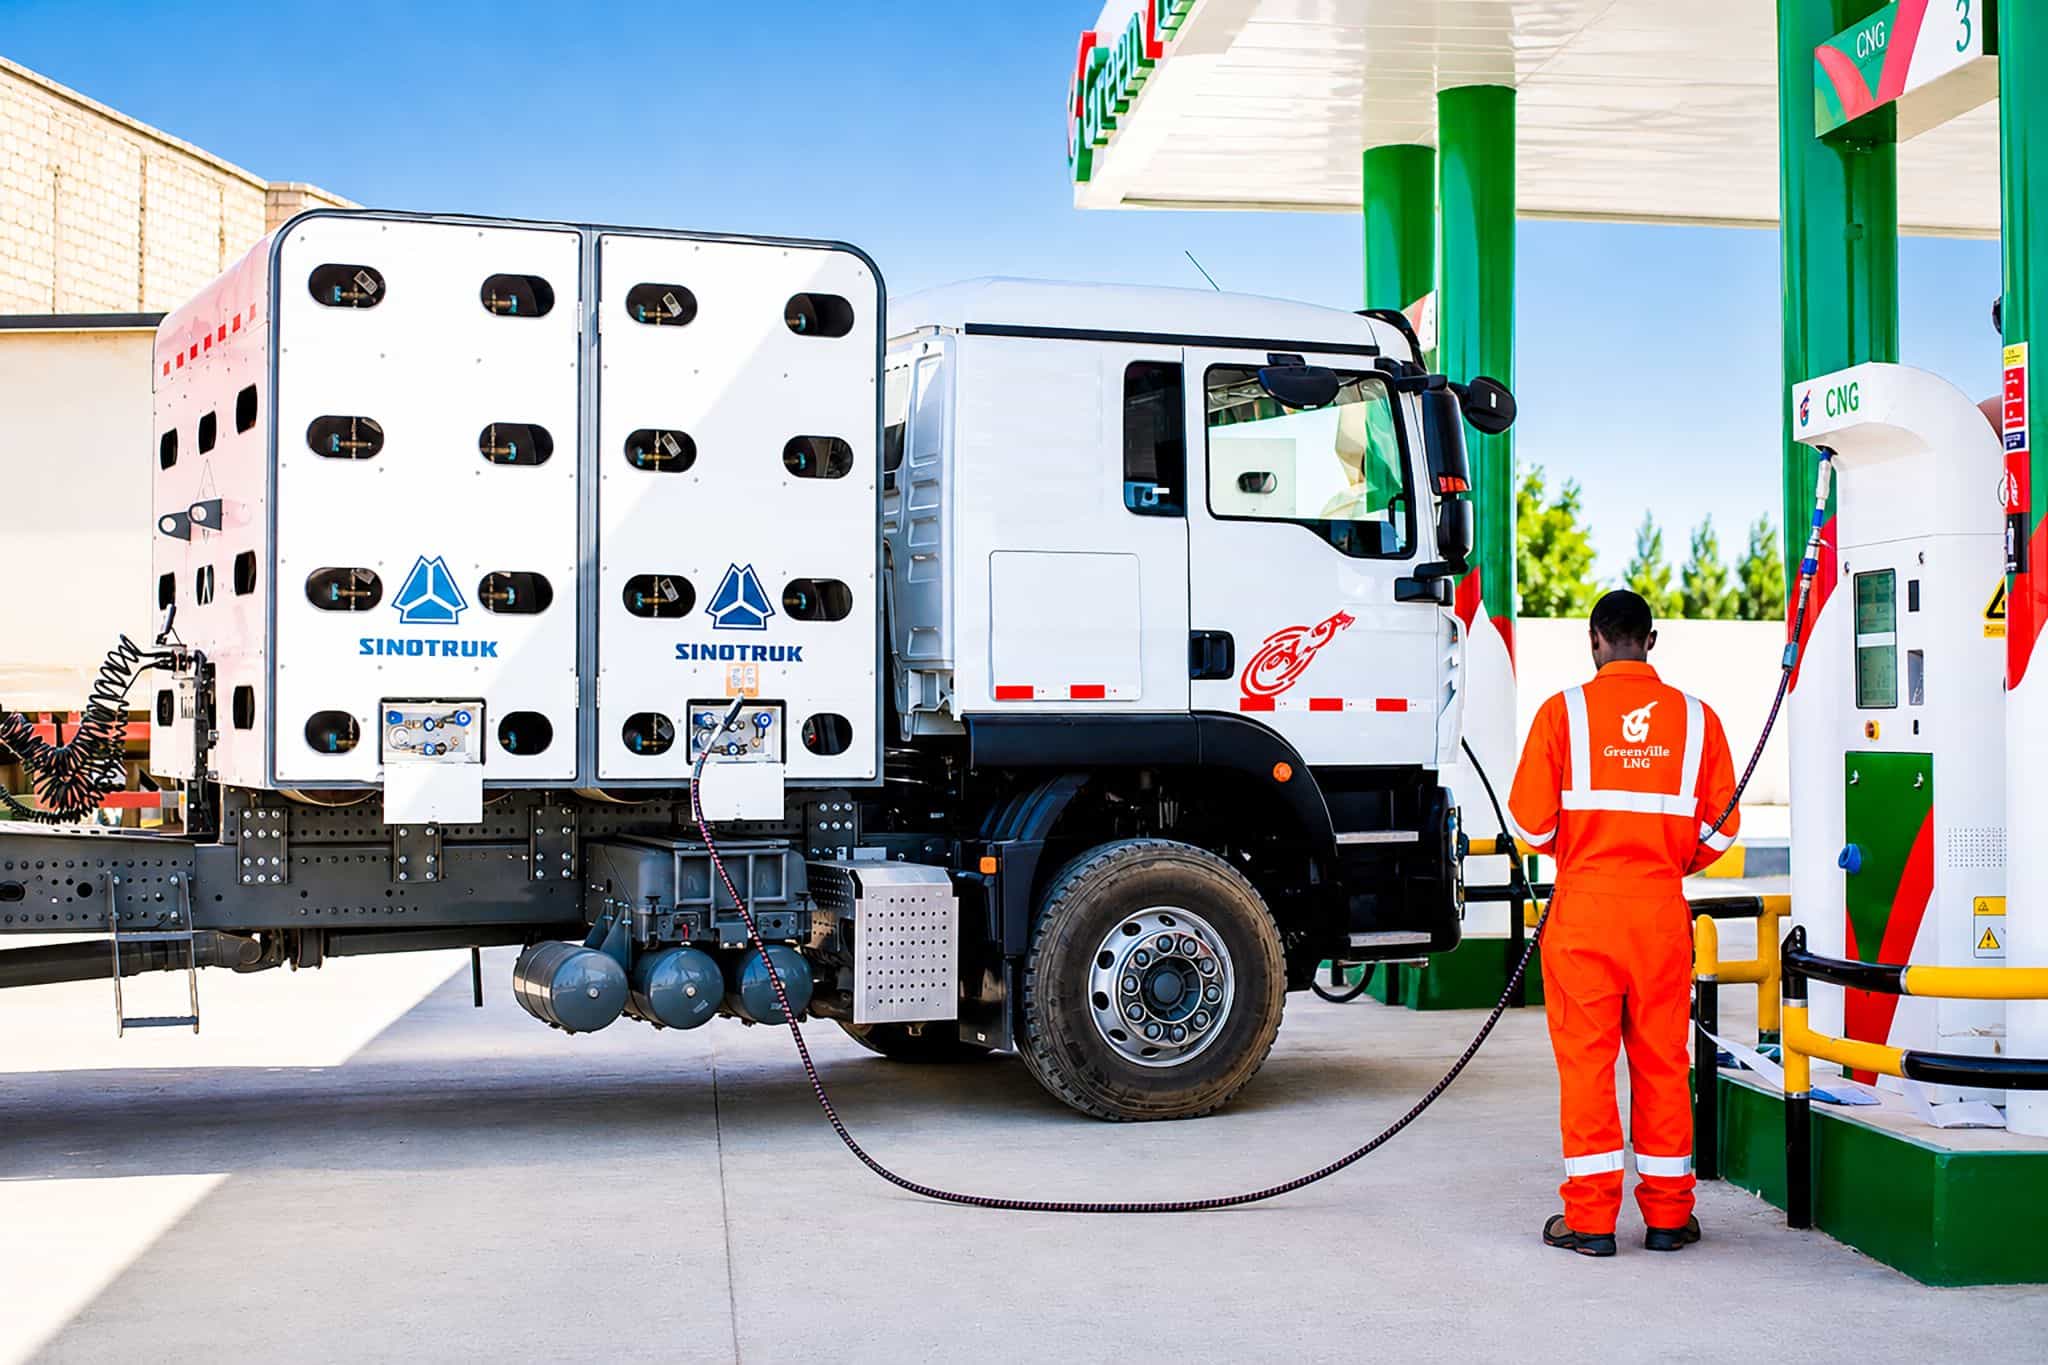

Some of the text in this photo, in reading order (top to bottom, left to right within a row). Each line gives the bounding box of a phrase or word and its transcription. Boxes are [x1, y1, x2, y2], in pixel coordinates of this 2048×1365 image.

[1955, 0, 1972, 52] 3
[1856, 21, 1885, 58] CNG
[1826, 382, 1860, 417] CNG
[359, 637, 498, 658] SINOTRUK
[675, 643, 803, 662] SINOTRUK
[1603, 745, 1670, 757] Greenville
[1623, 758, 1650, 768] LNG
